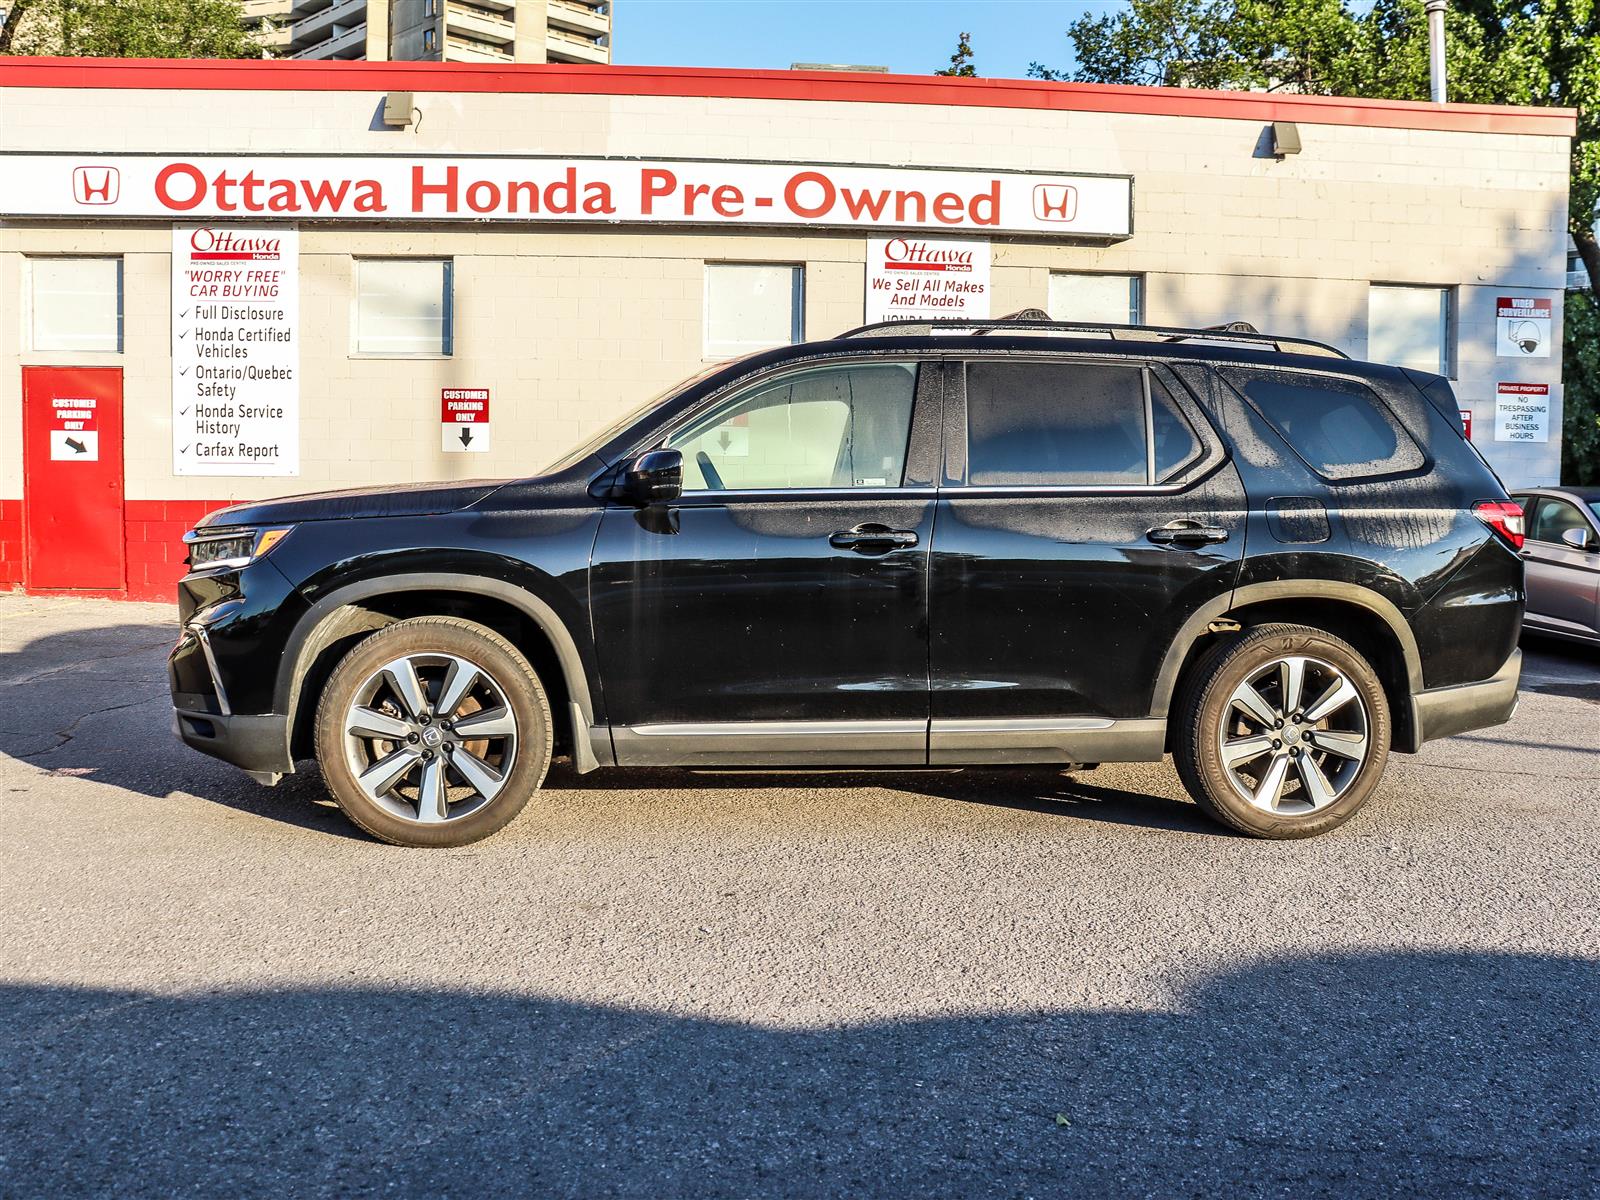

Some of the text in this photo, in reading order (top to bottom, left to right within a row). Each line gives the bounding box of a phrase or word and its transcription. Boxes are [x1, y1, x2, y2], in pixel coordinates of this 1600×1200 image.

[154, 162, 1001, 226] Ottawa Honda Pre-Owned
[190, 227, 281, 252] Ottawa
[252, 252, 279, 261] Honda
[884, 237, 973, 264] Ottawa
[945, 264, 972, 272] Honda
[185, 270, 286, 282] "WORRY FREE"
[190, 285, 279, 297] CAR BUYING
[872, 278, 985, 294] We Sell All Makes
[890, 294, 966, 308] And Models
[1511, 298, 1535, 308] VIDEO
[195, 305, 284, 321] Full Disclosure
[1498, 307, 1551, 317] SURVEILLANCE
[195, 327, 291, 342] Honda Certified
[196, 343, 248, 359] Vehicles
[196, 365, 293, 381] Ontario/Quebec
[197, 382, 236, 401] Safety
[443, 390, 488, 400] CUSTOMER
[52, 398, 97, 408] CUSTOMER
[447, 401, 484, 411] PARKING
[1499, 404, 1547, 413] TRESPASSING
[56, 409, 92, 419] PARKING
[195, 403, 283, 419] Honda Service
[455, 412, 476, 422] ONLY
[64, 421, 85, 430] ONLY
[196, 420, 241, 438] History
[1505, 423, 1540, 431] BUSINESS
[1509, 432, 1534, 440] HOURS
[195, 442, 279, 461] Carfax Report
